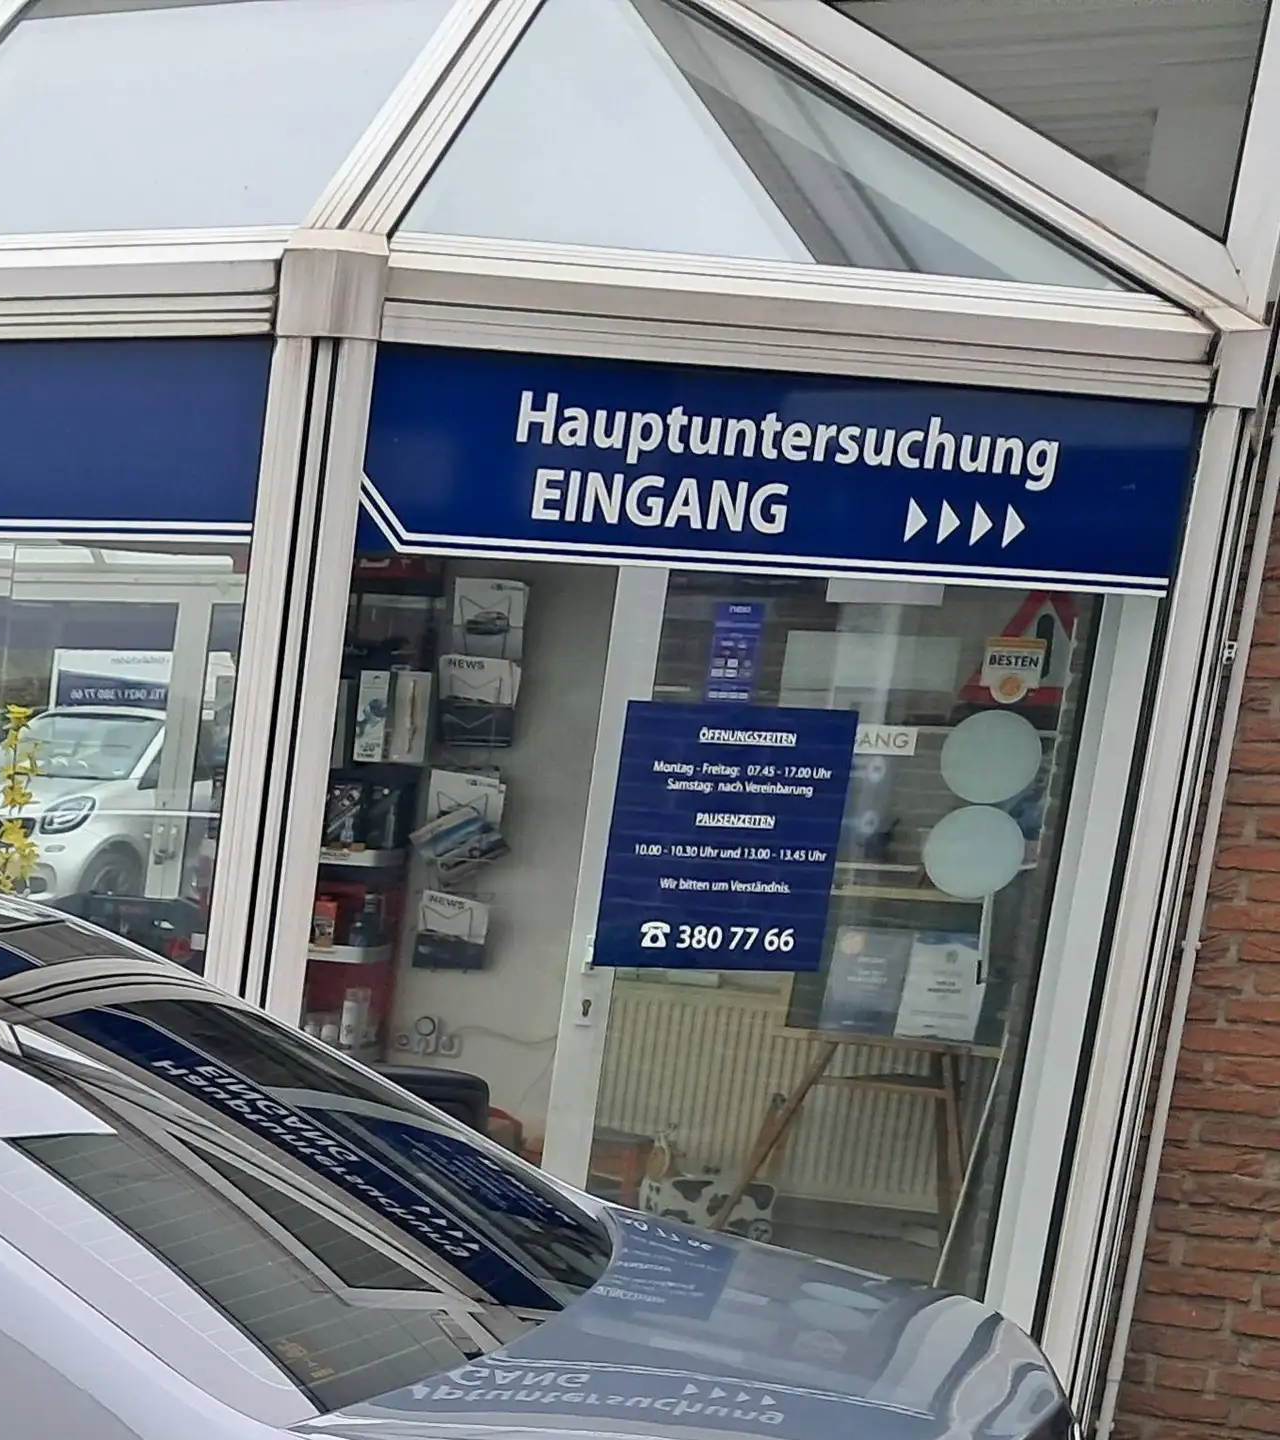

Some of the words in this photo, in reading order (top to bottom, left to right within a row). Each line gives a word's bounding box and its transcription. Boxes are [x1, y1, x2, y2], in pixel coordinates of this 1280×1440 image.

[515, 390, 1060, 492] Hauptuntersuchung
[530, 468, 789, 534] EINGANG
[448, 658, 485, 670] NEWS
[989, 653, 1040, 668] BESTEN
[698, 727, 797, 746] ÖFFNUNGSZEITEN
[855, 731, 910, 749] ANG
[653, 760, 693, 775] Montag
[702, 763, 740, 778] Freitag:
[747, 764, 775, 777] 07.45
[784, 766, 811, 779] 17.00
[812, 767, 832, 779] Uhr
[667, 778, 714, 793] Samstag:
[718, 780, 743, 792] nach
[744, 781, 813, 798] Vereinbarung
[695, 812, 775, 828] PAUSENZEITEN
[634, 844, 662, 855] 10.00
[671, 845, 697, 857] 10.30
[700, 847, 718, 858] Uhr
[720, 848, 740, 859] und
[743, 848, 770, 860] 13.00
[779, 849, 806, 861] 13.45
[808, 851, 827, 862] Uhr
[660, 878, 678, 889] Wir
[679, 878, 709, 891] bitten
[712, 882, 728, 892] um
[730, 880, 790, 894] Verständnis.
[675, 924, 723, 950] 380
[728, 926, 760, 950] 77
[763, 928, 795, 952] 66
